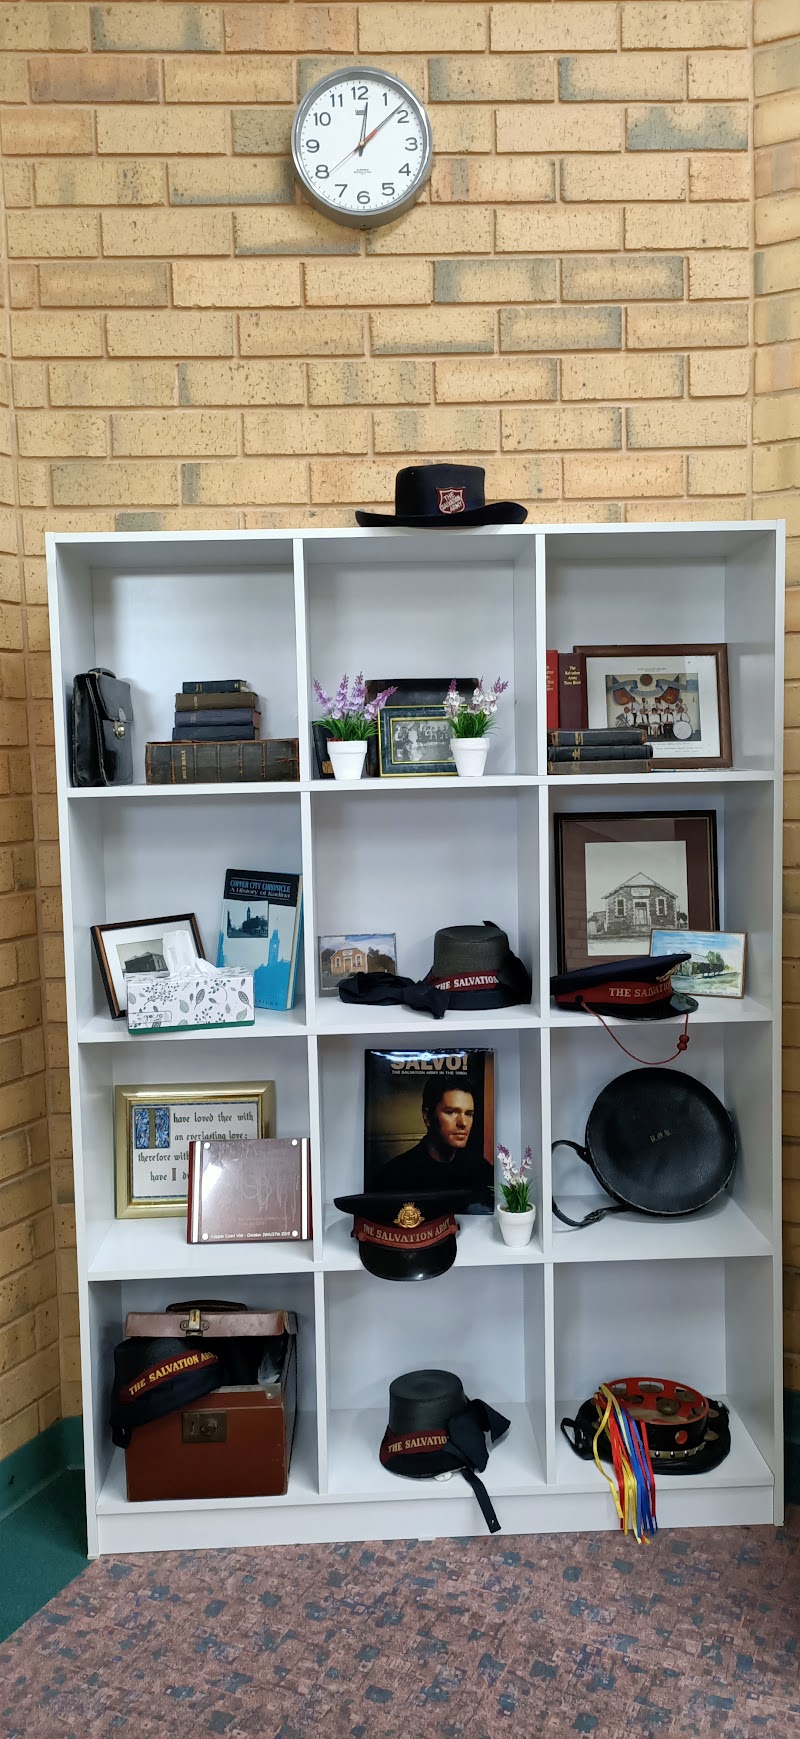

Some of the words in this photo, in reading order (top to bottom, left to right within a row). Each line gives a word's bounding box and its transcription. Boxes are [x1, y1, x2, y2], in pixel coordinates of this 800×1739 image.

[351, 86, 368, 100] 12
[382, 93, 388, 106] 1
[330, 94, 343, 107] 11
[314, 112, 331, 126] 10
[397, 110, 409, 124] 2
[306, 139, 320, 153] 9
[404, 137, 418, 151] 3
[315, 164, 329, 179] 8
[398, 163, 411, 176] 4
[334, 184, 348, 198] 7
[382, 182, 394, 196] 5
[356, 190, 370, 204] 6
[443, 491, 456, 500] THE
[230, 880, 249, 888] COPPER
[250, 882, 261, 890] CITY
[262, 883, 290, 892] CHRONICLE
[434, 980, 450, 990] THE
[454, 976, 499, 988] SALVATION
[609, 988, 631, 997] THE
[634, 981, 672, 997] SALVATIO
[390, 1055, 468, 1070] SALVO!
[173, 1113, 190, 1123] have
[194, 1112, 214, 1122] loved
[217, 1112, 232, 1123] thee
[237, 1111, 254, 1122] with
[186, 1131, 226, 1140] everlasting
[138, 1152, 171, 1163] therefore
[150, 1171, 167, 1182] have
[363, 1223, 374, 1236] THE
[375, 1229, 433, 1243] SALVATION
[435, 1218, 450, 1236] ARMY
[128, 1378, 146, 1396] THE
[148, 1354, 200, 1382] SALVATION
[200, 1352, 218, 1363] AR
[388, 1442, 402, 1453] THE
[405, 1436, 449, 1449] SALVATIO
